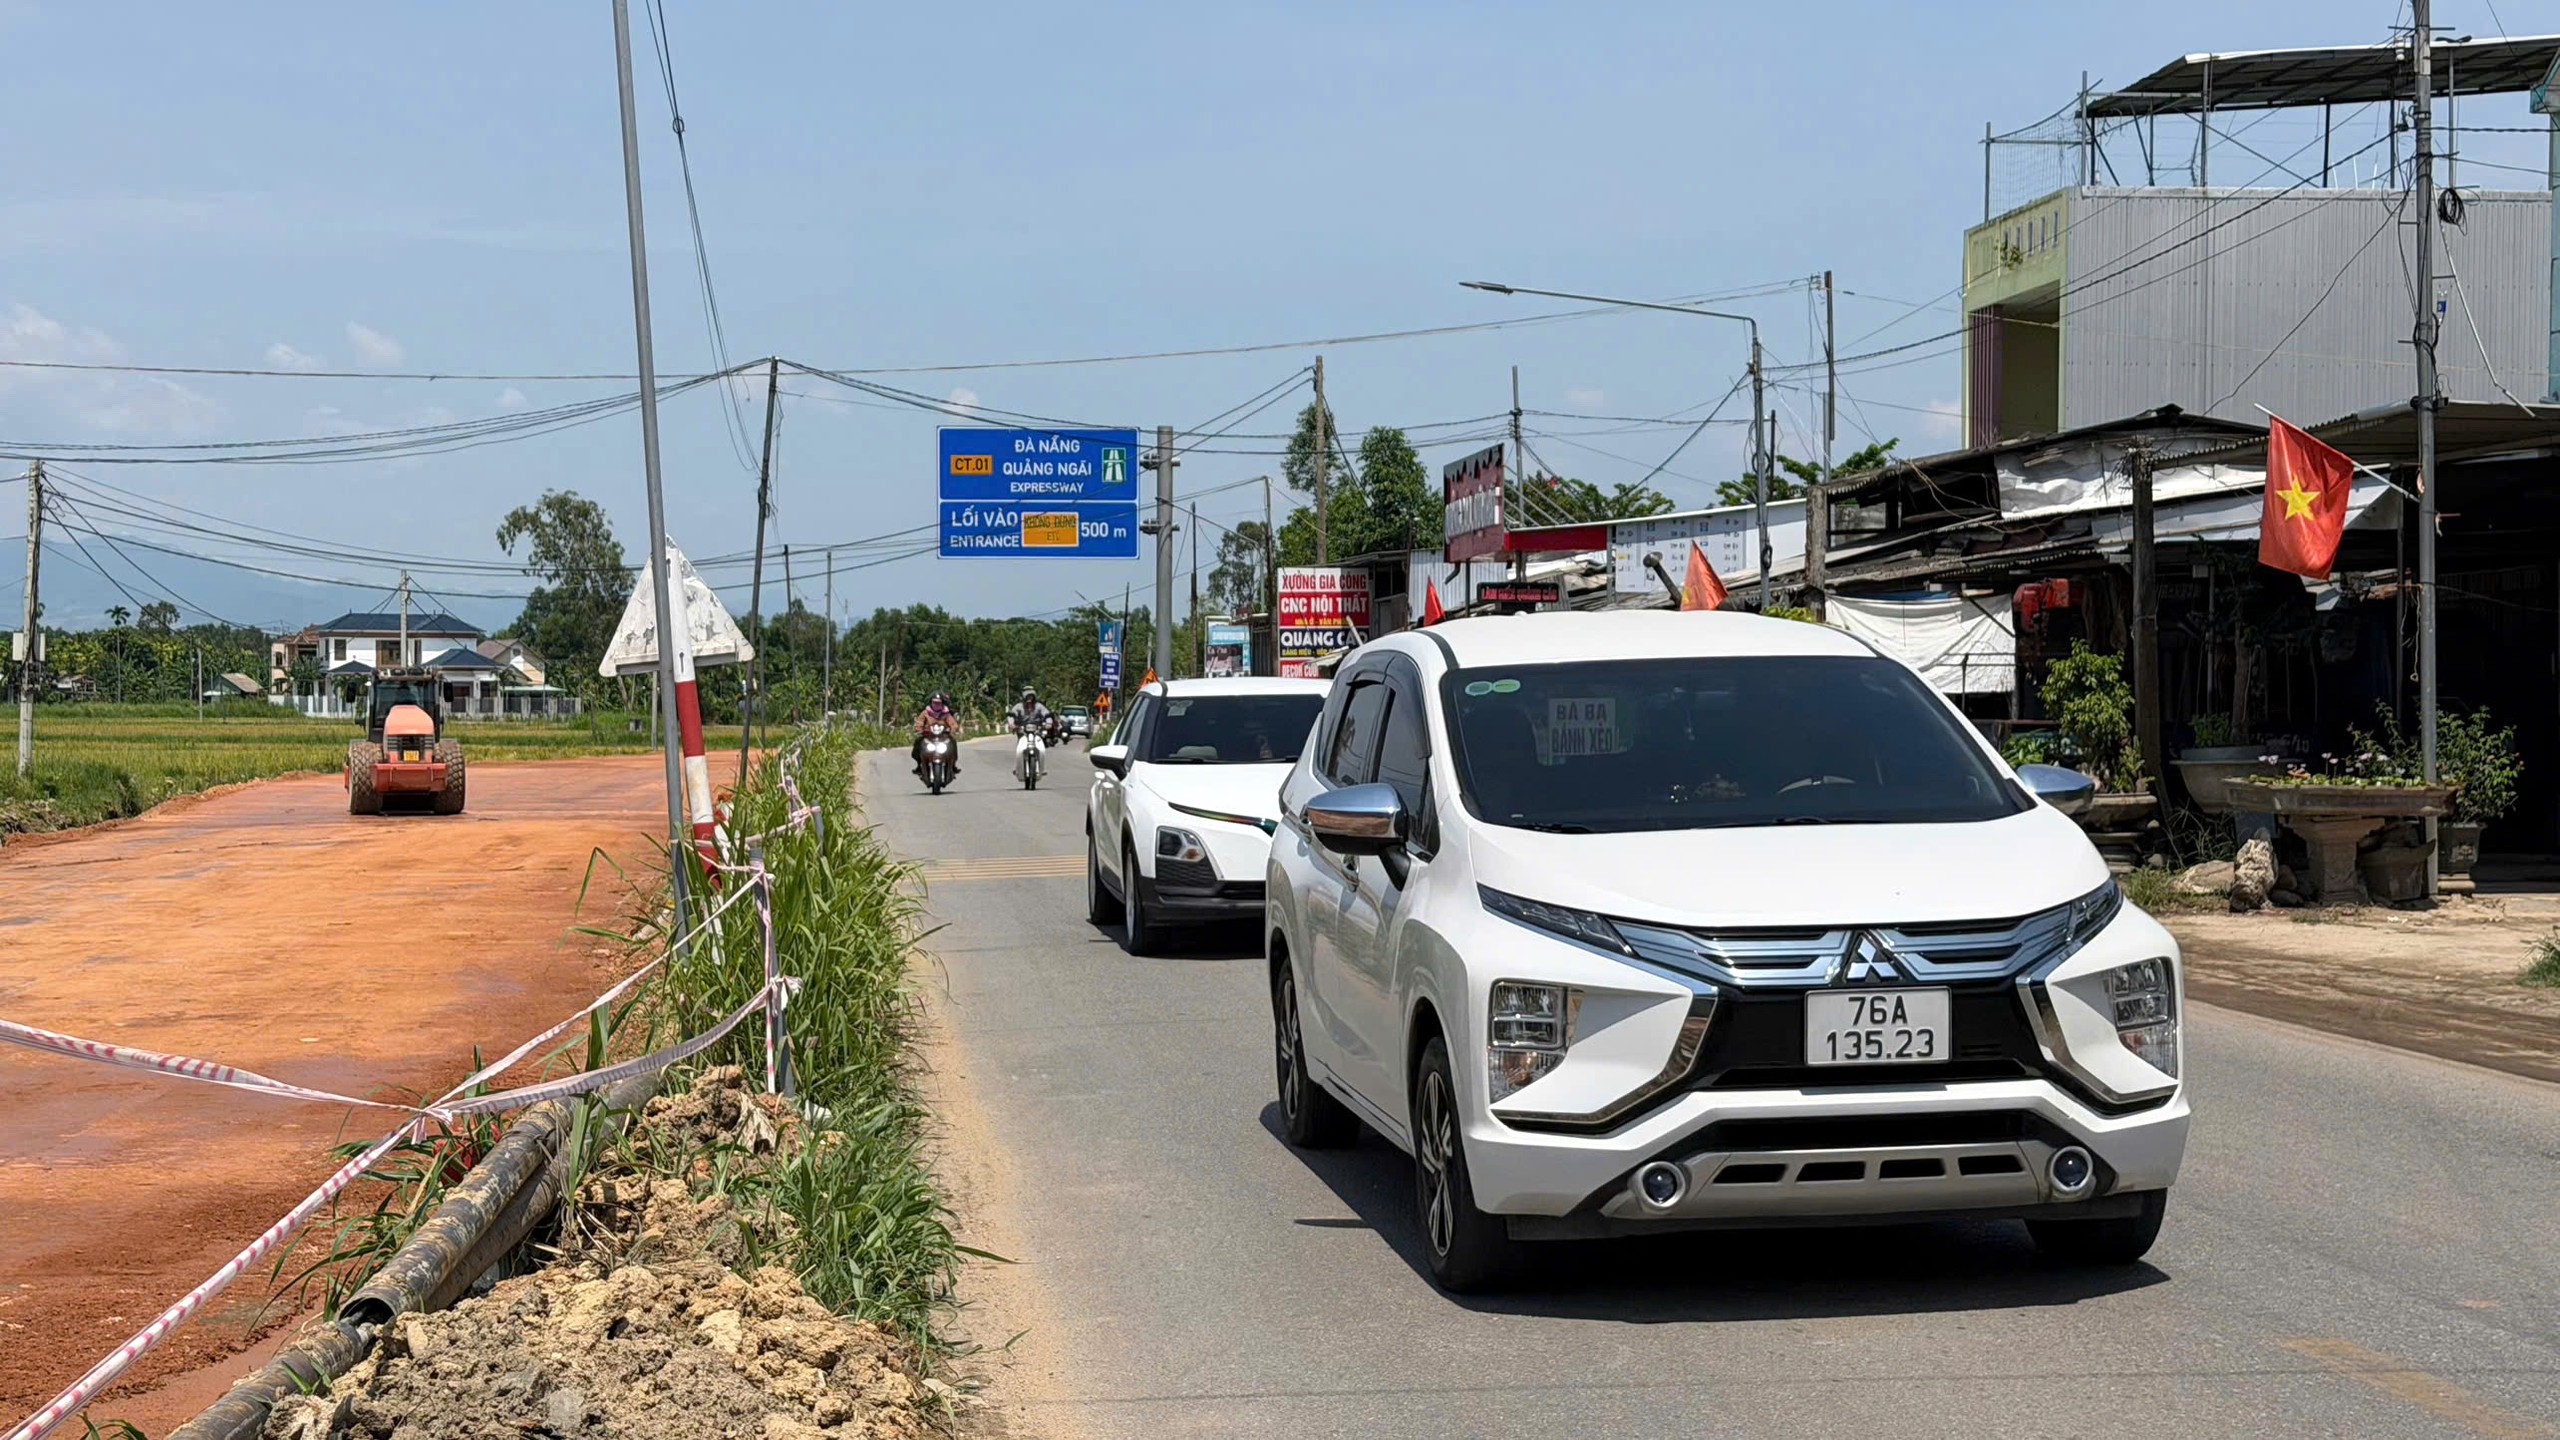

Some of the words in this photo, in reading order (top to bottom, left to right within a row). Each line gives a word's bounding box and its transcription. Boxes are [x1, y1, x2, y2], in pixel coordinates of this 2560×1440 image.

[1014, 436, 1036, 453] ĐÀ
[955, 458, 989, 472] CT.01
[1002, 458, 1054, 476] QUẢNG
[1057, 460, 1092, 476] NGÃI
[1010, 482, 1084, 493] EXPRESSWAY
[951, 504, 979, 527] LỐI
[983, 506, 1018, 528] VÀO
[1081, 522, 1109, 538] 500
[1113, 527, 1127, 538] m
[950, 535, 1020, 548] ENTRANCE
[1282, 570, 1316, 590] XƯỞNG
[1319, 574, 1336, 590] GIA
[1339, 570, 1367, 590] CÔNG
[1280, 597, 1308, 613] CNC
[1310, 594, 1334, 616] NỘI
[1335, 592, 1368, 613] THẤT
[1281, 627, 1334, 646] QUẢNG
[1848, 994, 1908, 1026] 76A
[1826, 1028, 1934, 1062] 135.23
